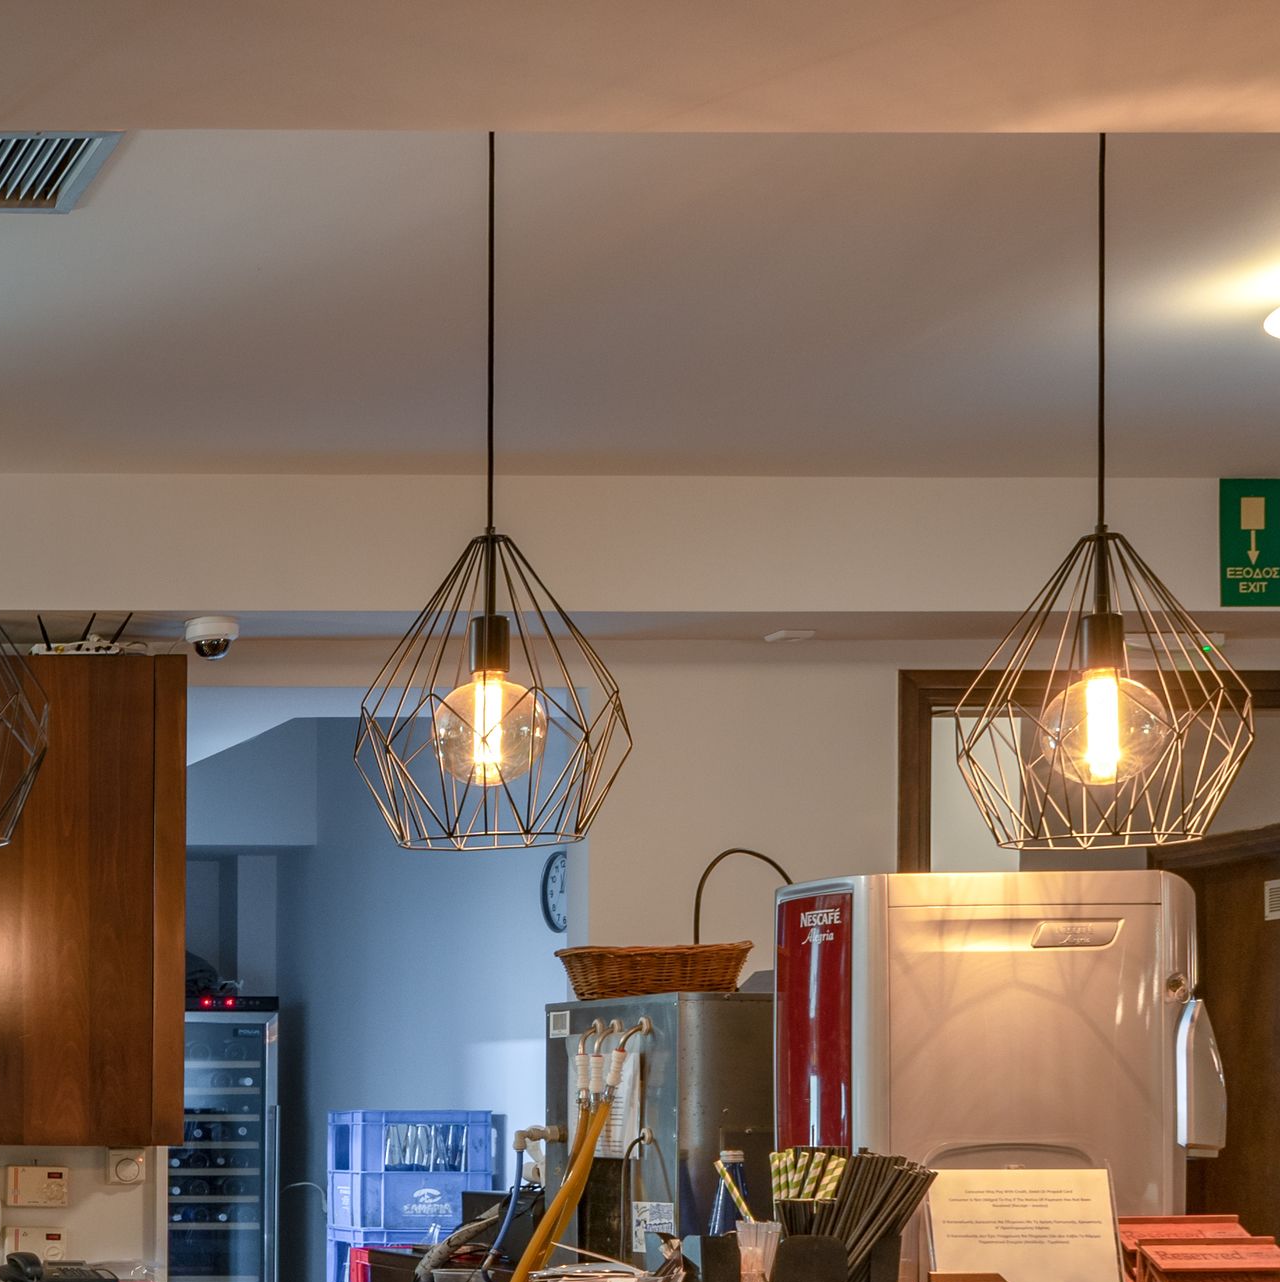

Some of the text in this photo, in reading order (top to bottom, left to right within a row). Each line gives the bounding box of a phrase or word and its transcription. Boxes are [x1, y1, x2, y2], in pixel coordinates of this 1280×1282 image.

[1226, 567, 1279, 579] ΕΞΟΔΟΣ
[1239, 582, 1268, 593] EXIT
[800, 908, 841, 928] NESCAFÉ
[801, 928, 834, 945] Alegria
[1154, 1250, 1244, 1261] Reserved
